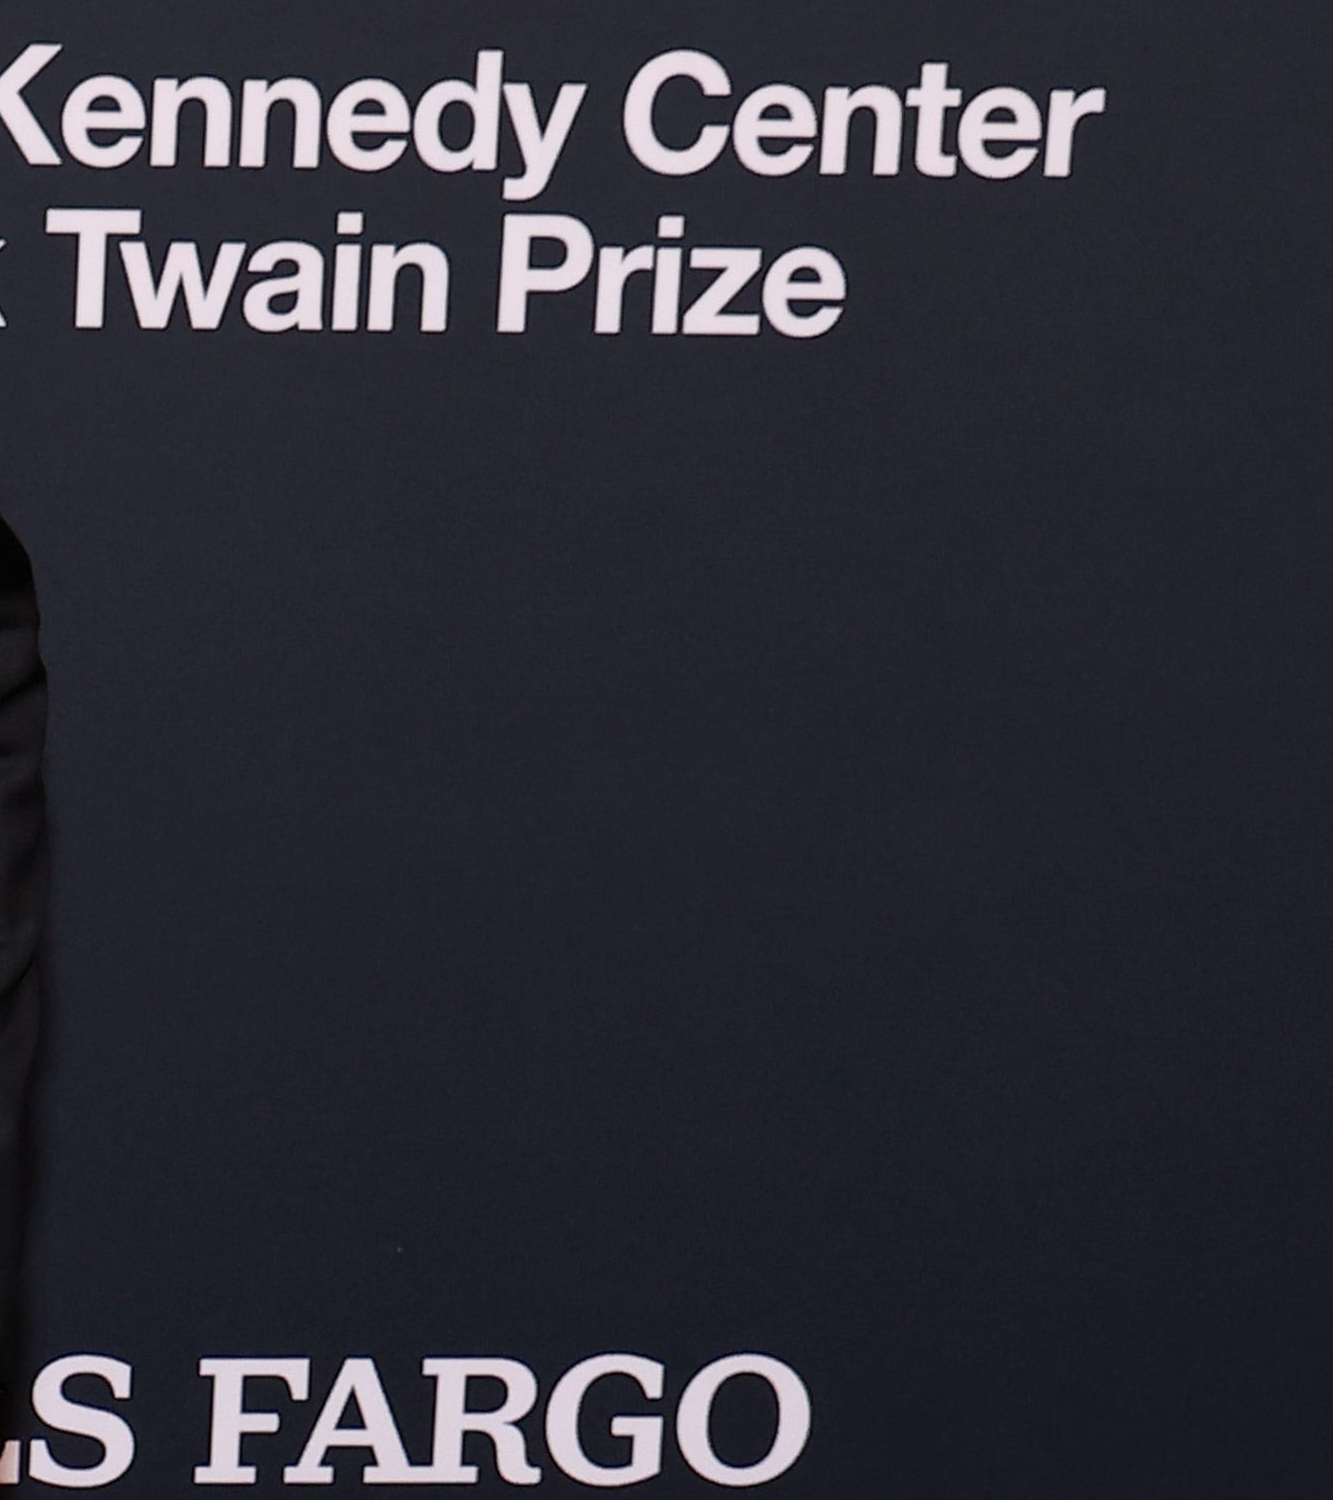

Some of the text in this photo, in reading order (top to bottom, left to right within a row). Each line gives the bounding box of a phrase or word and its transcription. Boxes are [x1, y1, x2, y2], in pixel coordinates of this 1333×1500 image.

[623, 49, 1107, 179] Center
[45, 208, 450, 334] Twain
[496, 213, 848, 339] Prize
[194, 1353, 811, 1487] FARGO
